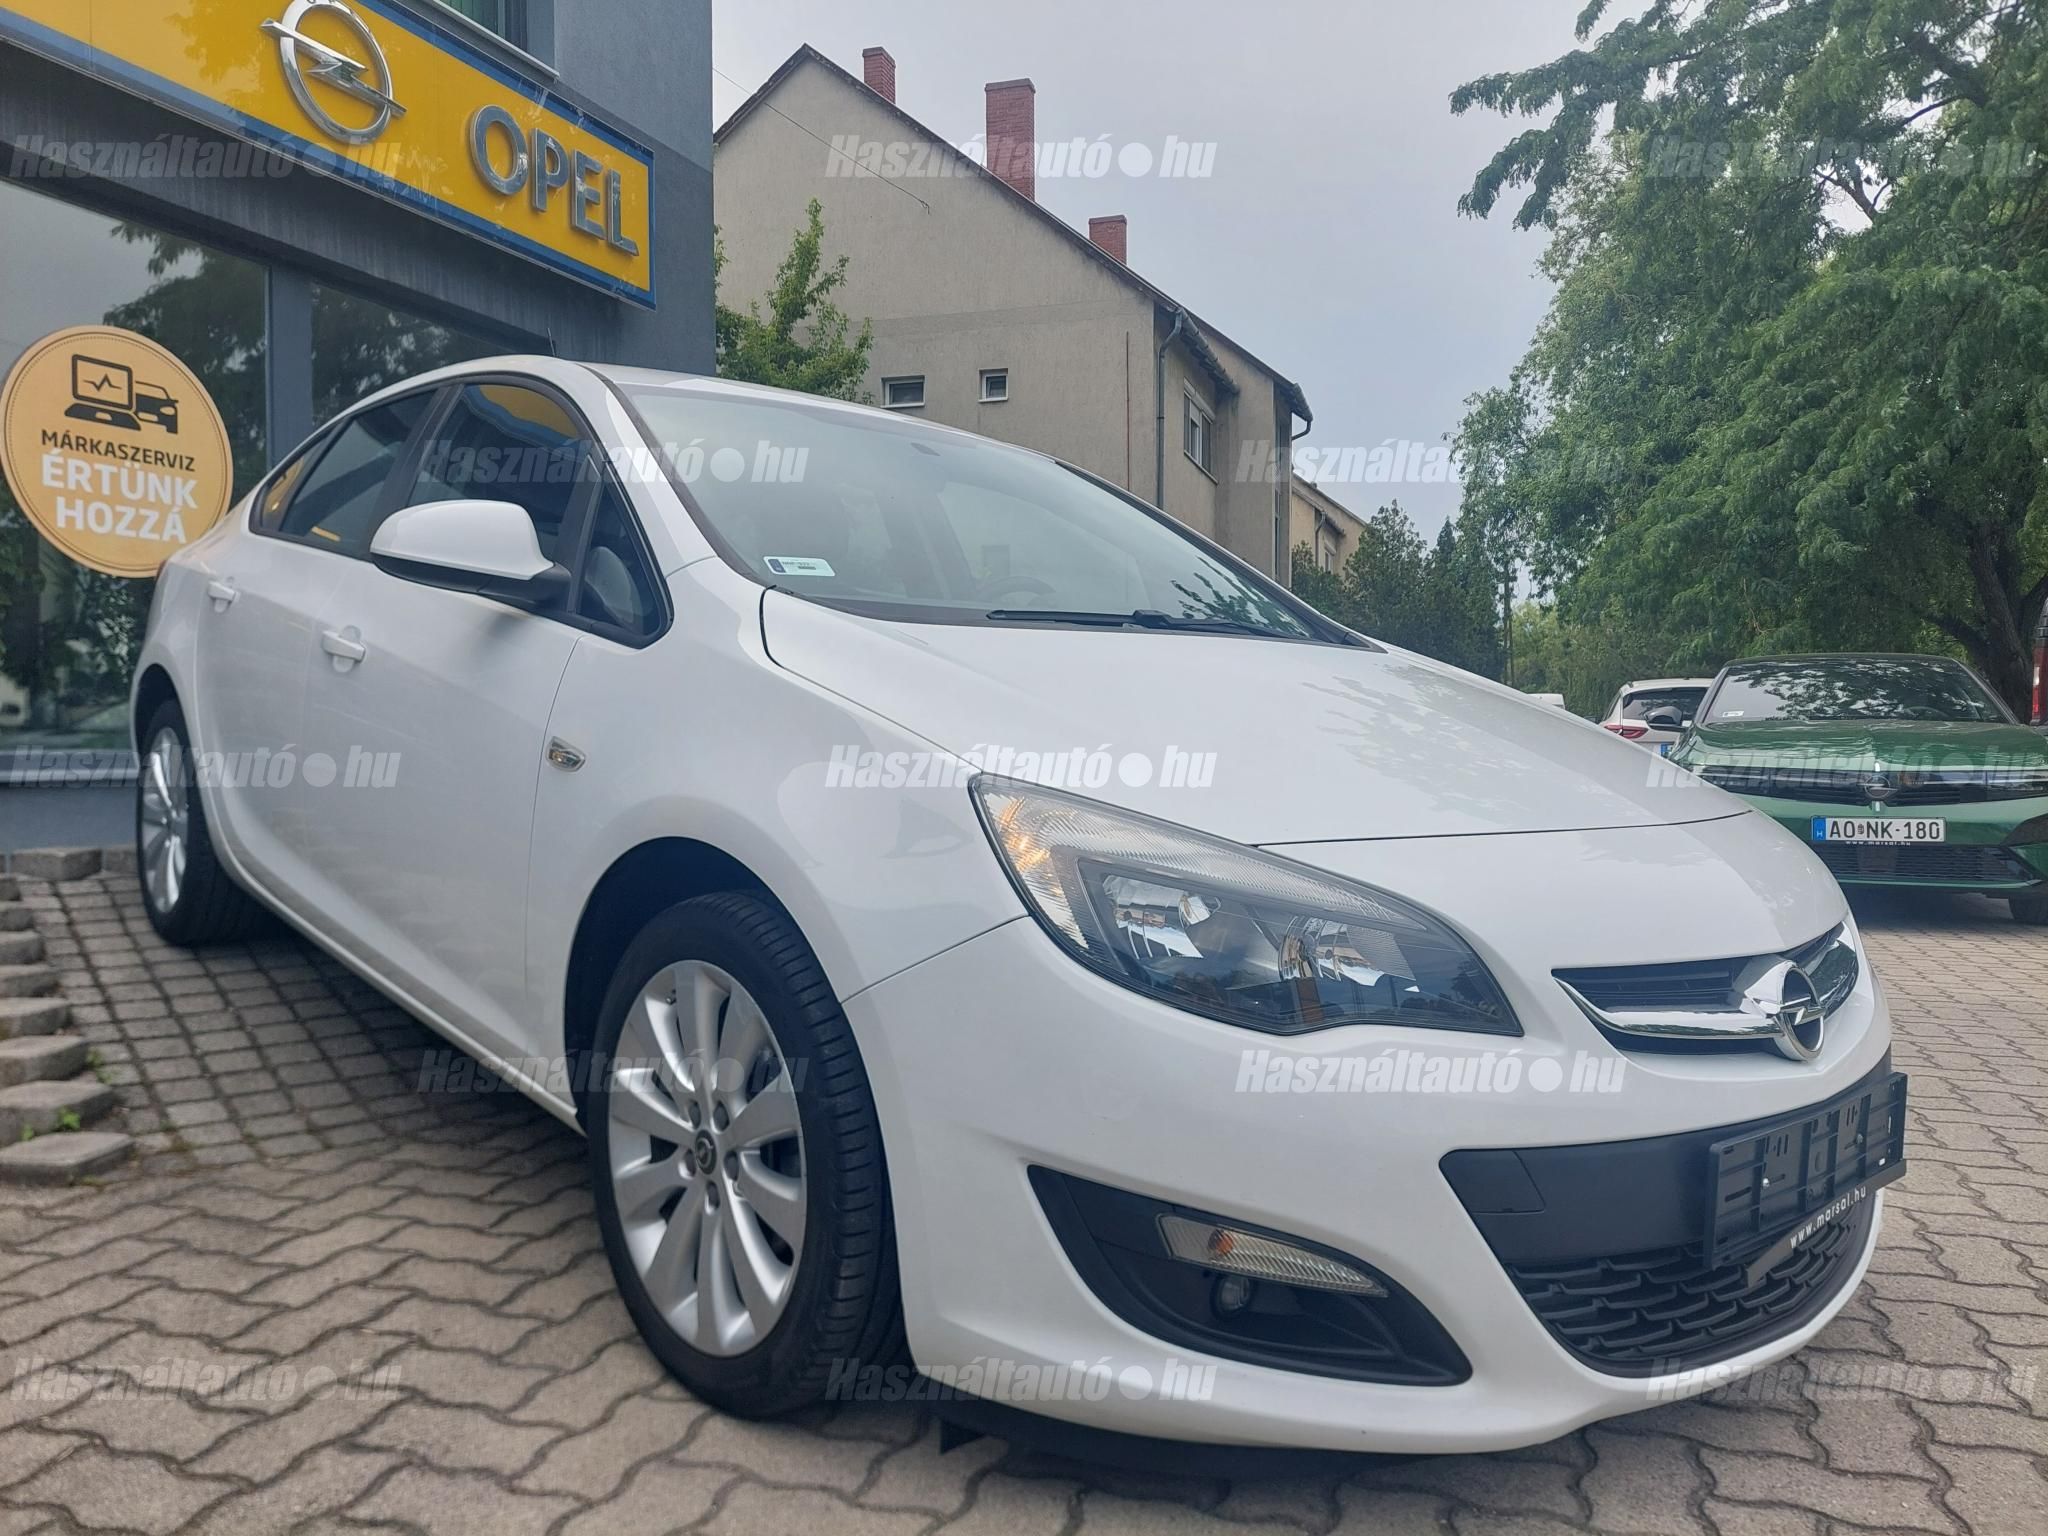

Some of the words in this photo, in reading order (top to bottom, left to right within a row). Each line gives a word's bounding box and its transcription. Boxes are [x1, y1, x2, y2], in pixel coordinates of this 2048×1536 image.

[470, 105, 639, 256] OPEL
[41, 429, 195, 472] MÁRKASZERVIZ
[41, 448, 198, 509] ÉRTÜNK
[56, 496, 187, 543] HOZZÁ
[1790, 1186, 1866, 1249] www.marsal.hu
